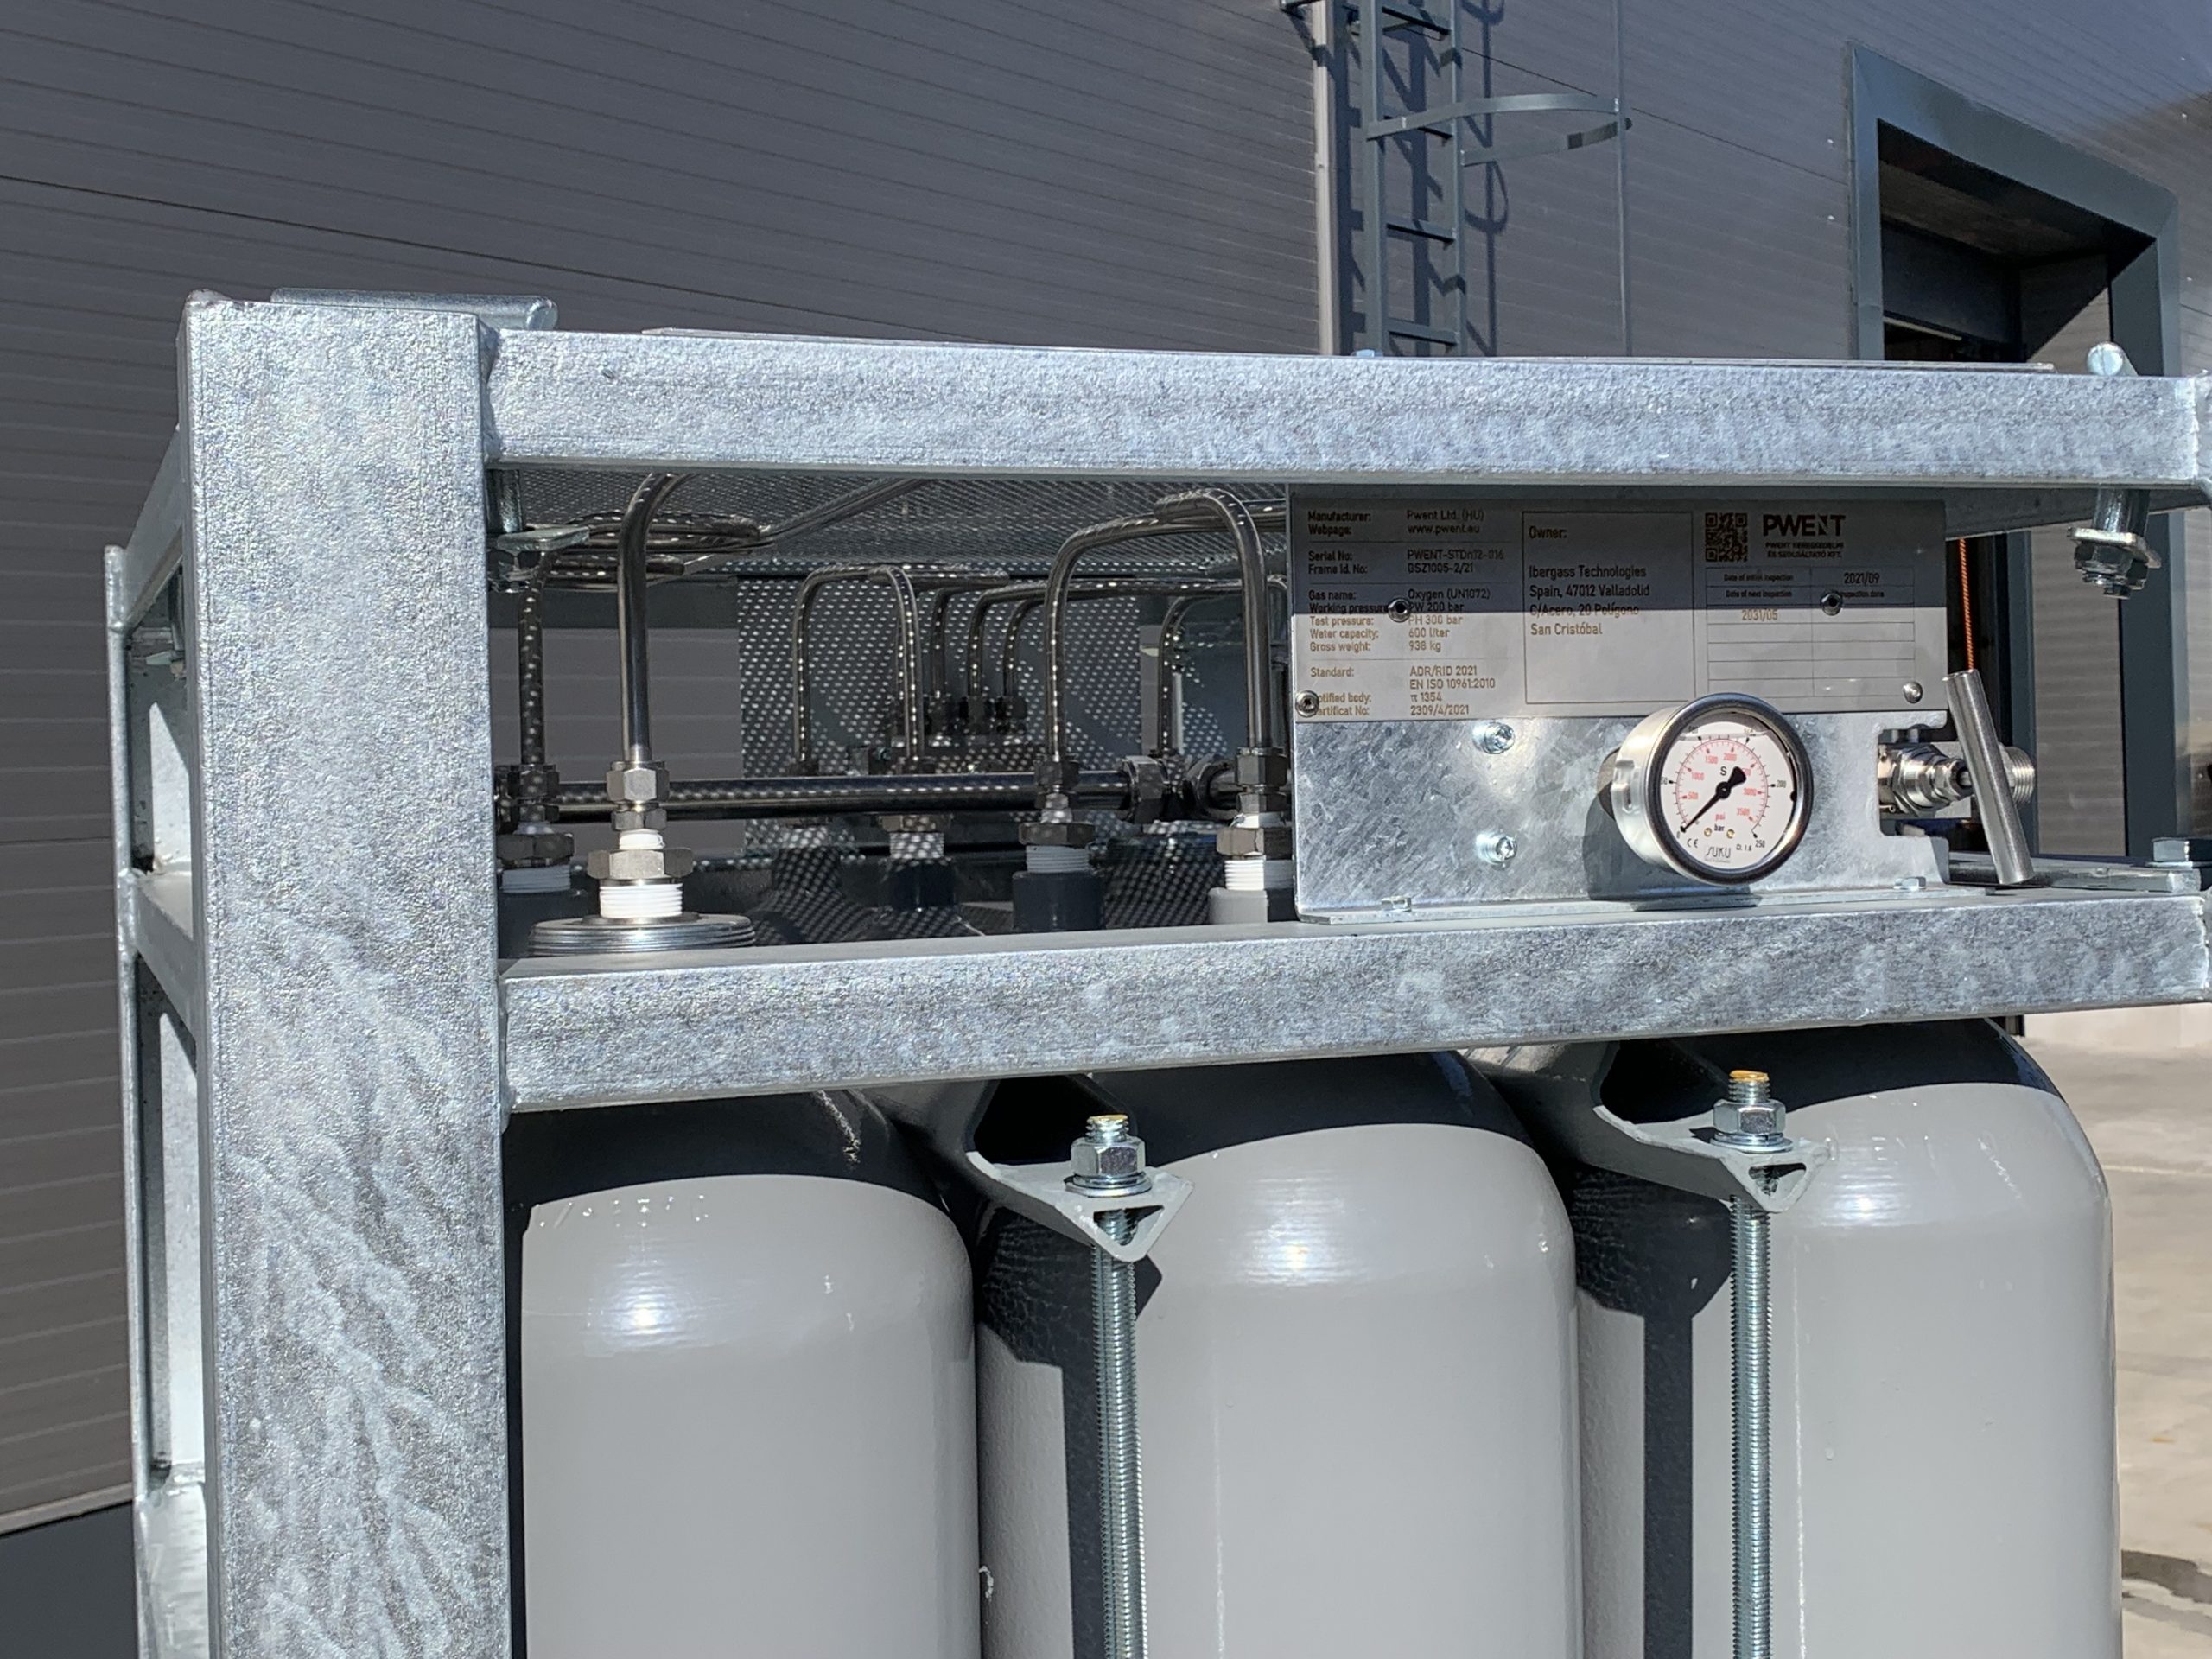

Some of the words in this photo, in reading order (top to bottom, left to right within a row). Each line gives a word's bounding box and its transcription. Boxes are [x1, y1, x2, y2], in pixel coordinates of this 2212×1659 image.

[1307, 511, 1371, 522] Manufacturer:
[1407, 510, 1439, 520] Pwent
[1462, 510, 1484, 521] (HU)
[1308, 524, 1352, 537] Webpage:
[1407, 524, 1480, 536] www.pwent.eu
[1763, 514, 1846, 537] PWENT
[1529, 525, 1567, 539] Owner:
[1308, 551, 1337, 561] Serial
[1338, 551, 1352, 561] No:
[1308, 564, 1338, 574] Frame
[1353, 563, 1368, 574] No:
[1529, 565, 1575, 580] Ibergass
[1579, 564, 1647, 580] Technologies
[1309, 590, 1326, 600] Gas
[1328, 591, 1357, 600] name:
[1408, 589, 1443, 602] Oxygen
[1446, 588, 1491, 601] (UN1072)
[1529, 585, 1563, 600] Spain,
[1566, 585, 1596, 596] 47012
[1599, 584, 1649, 596] Valladolid
[1309, 604, 1347, 614] Working
[1427, 603, 1445, 613] 200
[1447, 603, 1465, 613] bar
[1579, 604, 1592, 615] 20
[1594, 602, 1639, 618] Polígono
[1310, 616, 1330, 626] Test
[1332, 616, 1374, 627] pressure:
[1409, 615, 1423, 626] PH
[1426, 615, 1445, 625] 300
[1446, 614, 1464, 625] bar
[1408, 628, 1427, 638] 600
[1429, 627, 1450, 638] liter
[1530, 623, 1552, 635] San
[1554, 621, 1603, 635] Cristóbal
[1310, 629, 1337, 639] Water
[1339, 629, 1379, 641] capacity:
[1310, 642, 1336, 652] Gross
[1338, 641, 1371, 653] weight:
[1409, 641, 1427, 652] 938
[1429, 640, 1441, 652] kg
[1311, 667, 1355, 677] Standard:
[1410, 665, 1452, 677] ADR/RID
[1455, 665, 1478, 676] 2021
[1410, 679, 1424, 690] EN
[1427, 679, 1444, 690] ISO
[1317, 692, 1345, 702] otified
[1348, 692, 1372, 705] body:
[1421, 692, 1442, 702] 1354
[1355, 704, 1370, 715] No:
[1713, 823, 1725, 832] bar
[1706, 846, 1731, 858] SUKU
